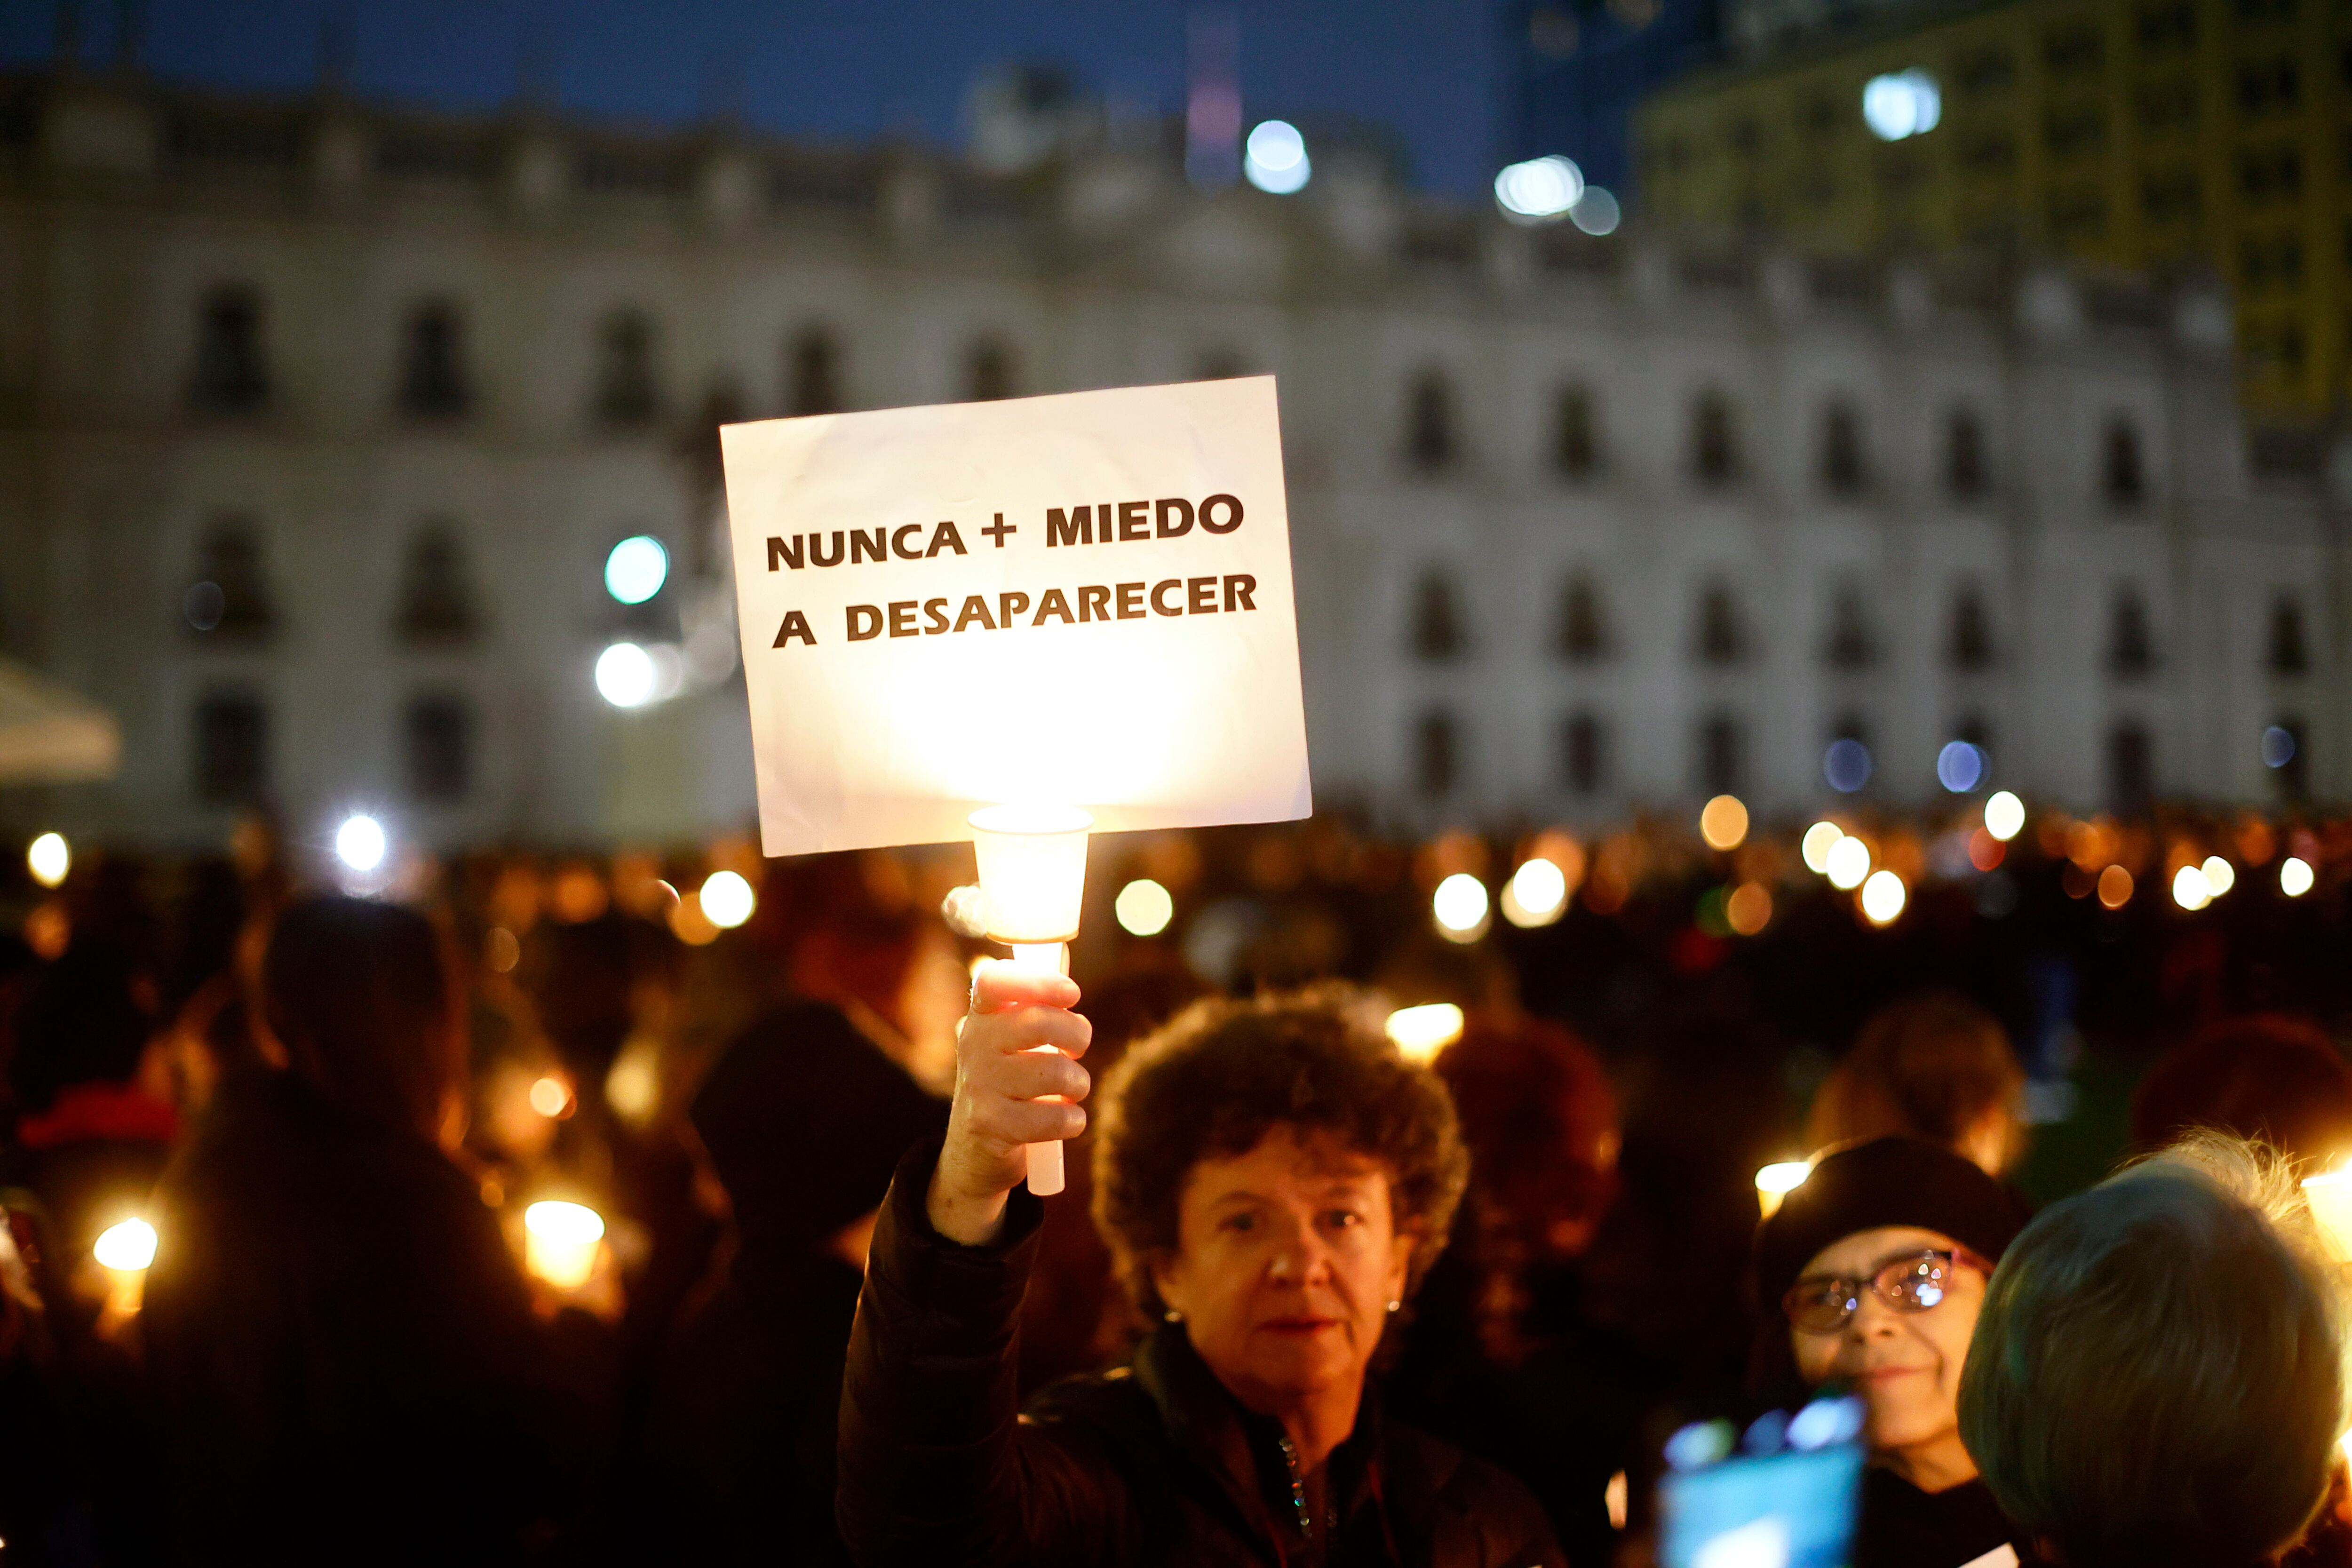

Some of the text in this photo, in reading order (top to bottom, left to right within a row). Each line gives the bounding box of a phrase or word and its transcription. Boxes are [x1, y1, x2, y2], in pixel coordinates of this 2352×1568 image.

[766, 493, 1244, 572] NUNCA + MIEDO
[772, 574, 1257, 649] A DESAPARECER
